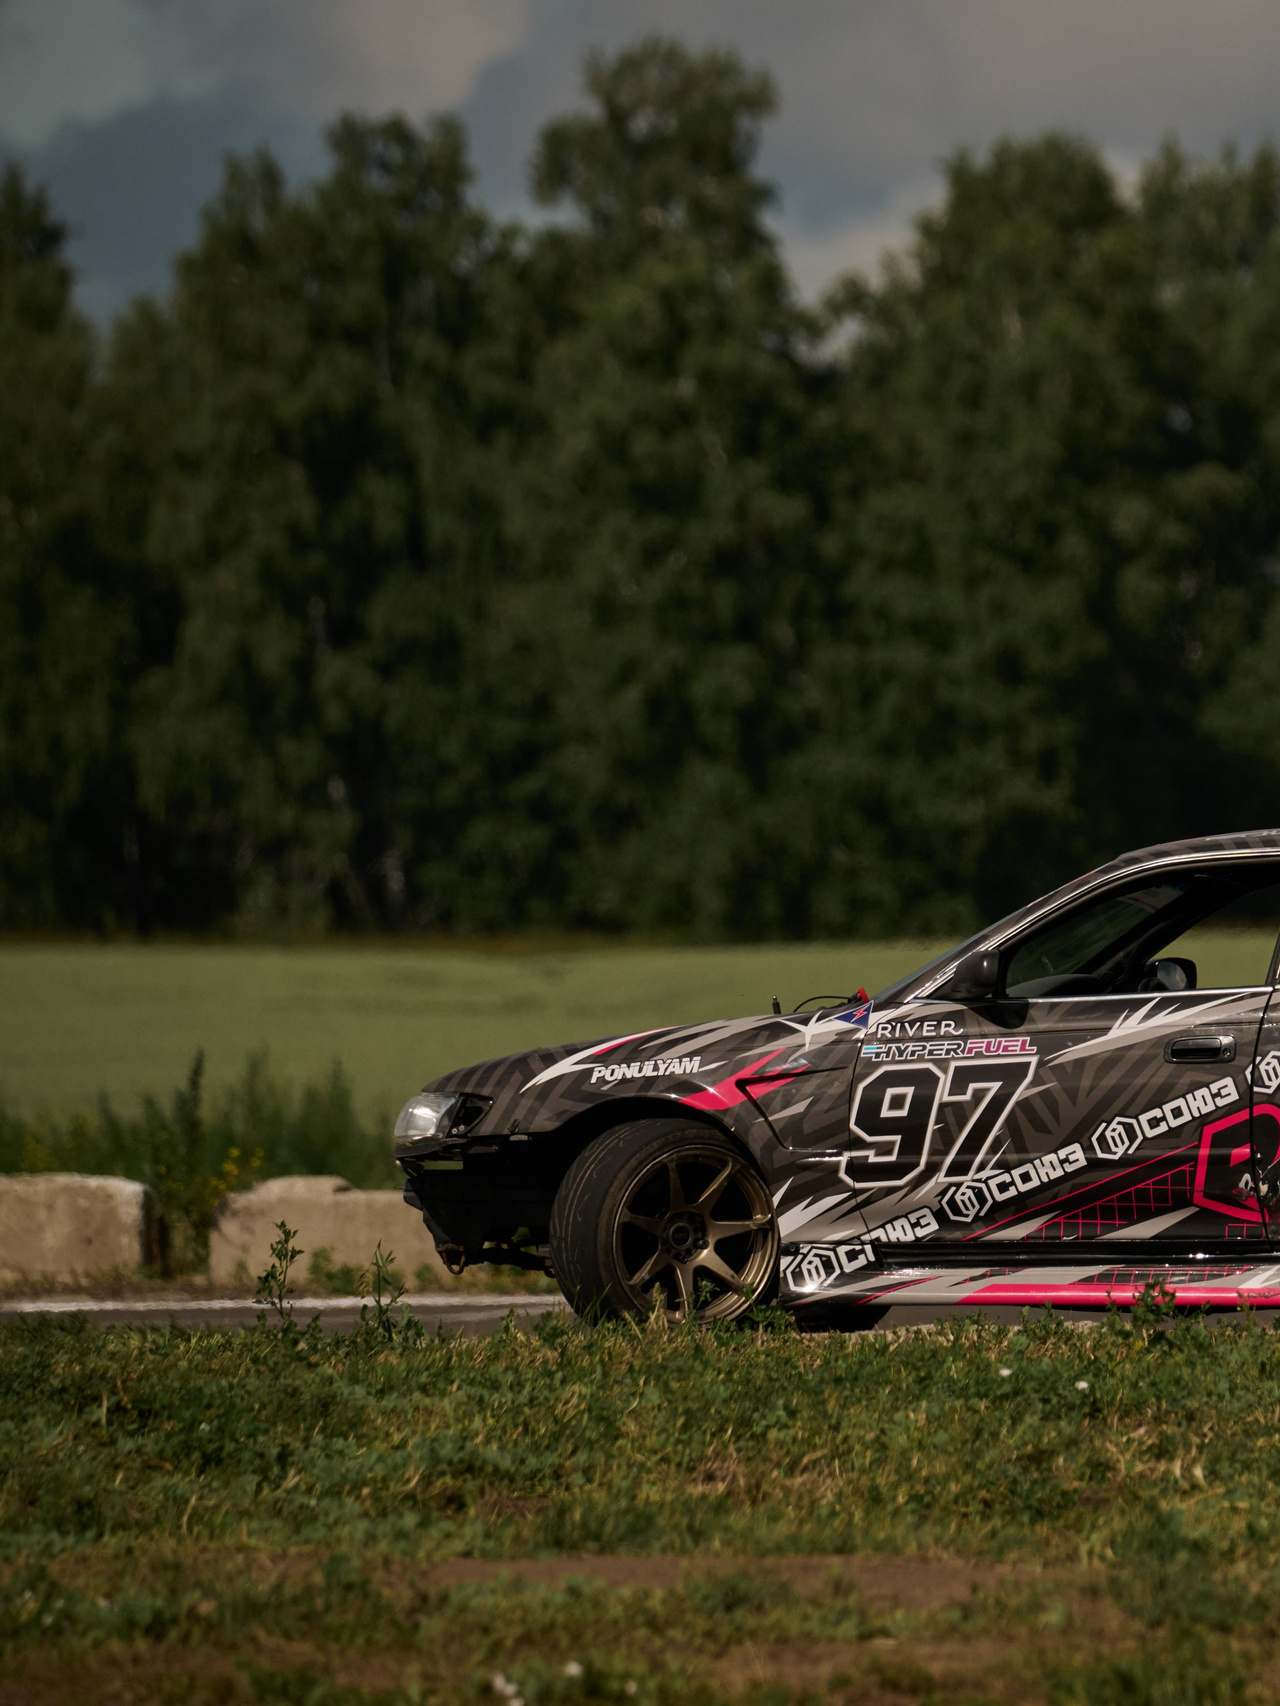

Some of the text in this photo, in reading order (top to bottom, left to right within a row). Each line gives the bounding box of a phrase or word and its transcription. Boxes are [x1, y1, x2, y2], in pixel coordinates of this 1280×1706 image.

[877, 1020, 964, 1039] RIVER
[590, 1056, 702, 1084] PONULYAM
[838, 1054, 1040, 1188] 97
